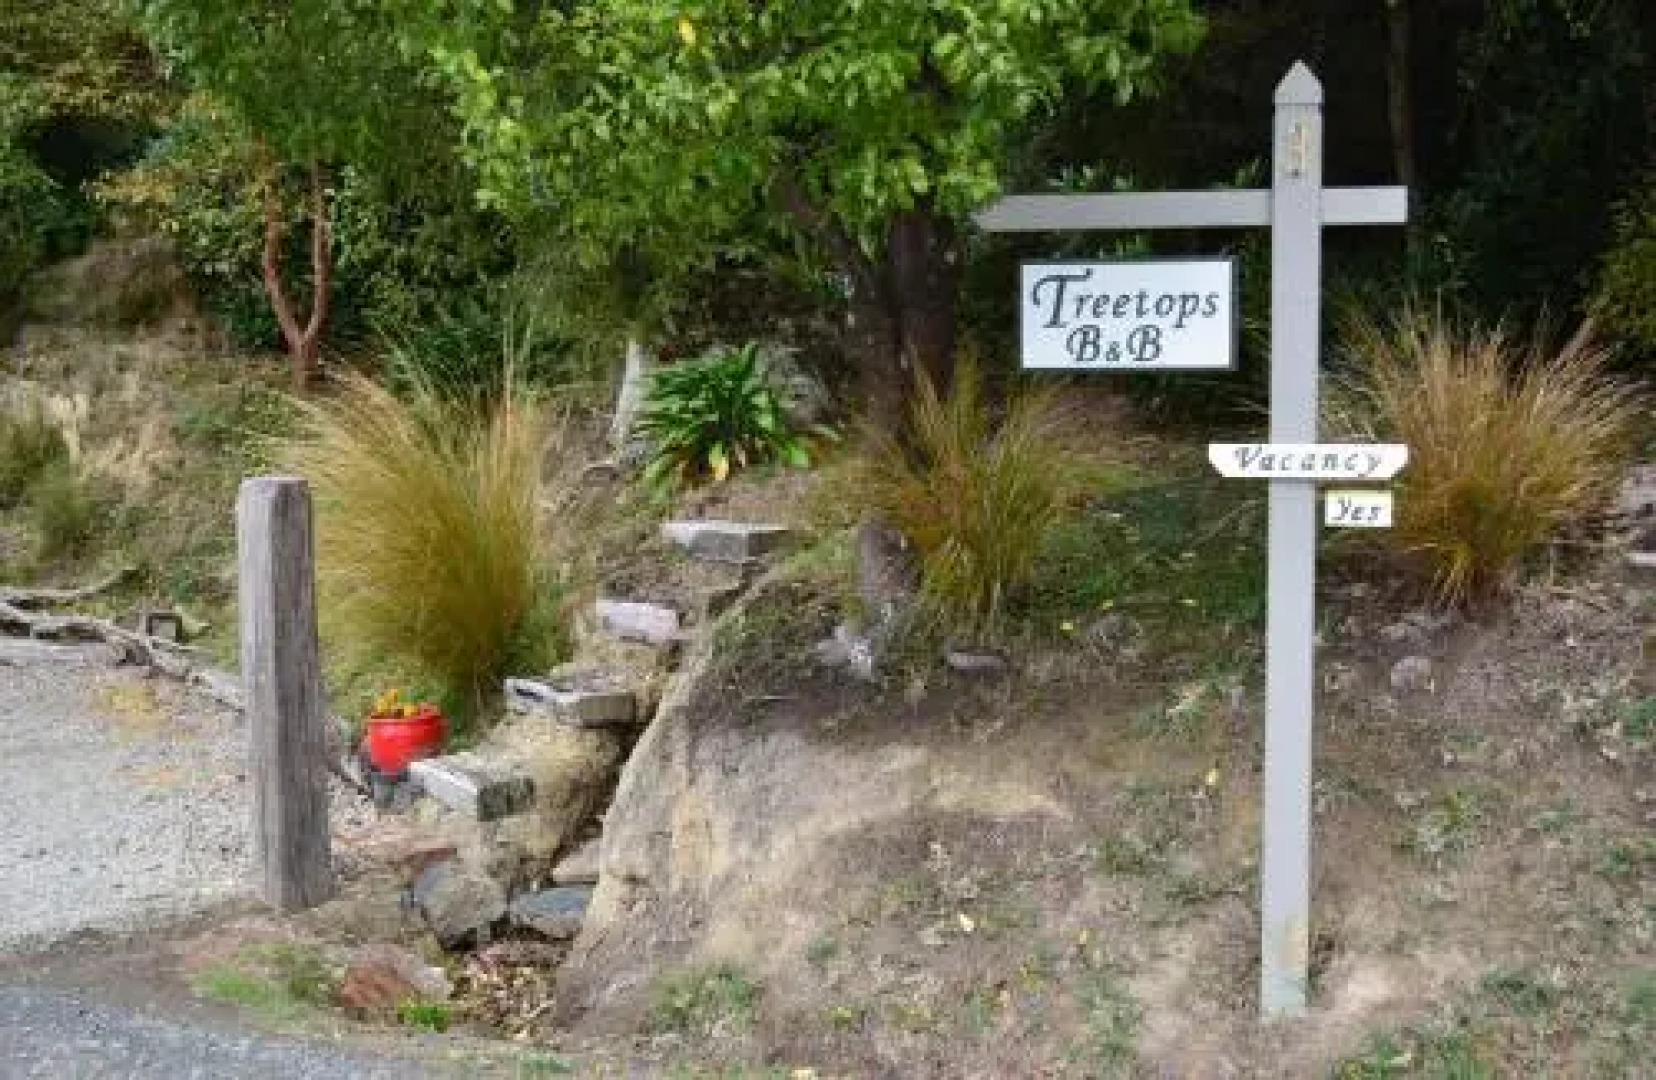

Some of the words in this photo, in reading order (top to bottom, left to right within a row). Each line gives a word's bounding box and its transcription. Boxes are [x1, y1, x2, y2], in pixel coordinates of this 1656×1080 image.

[1032, 267, 1220, 328] Treetops
[1065, 324, 1164, 362] B&B
[1234, 446, 1383, 477] Vacancy
[1331, 497, 1382, 521] Yes
